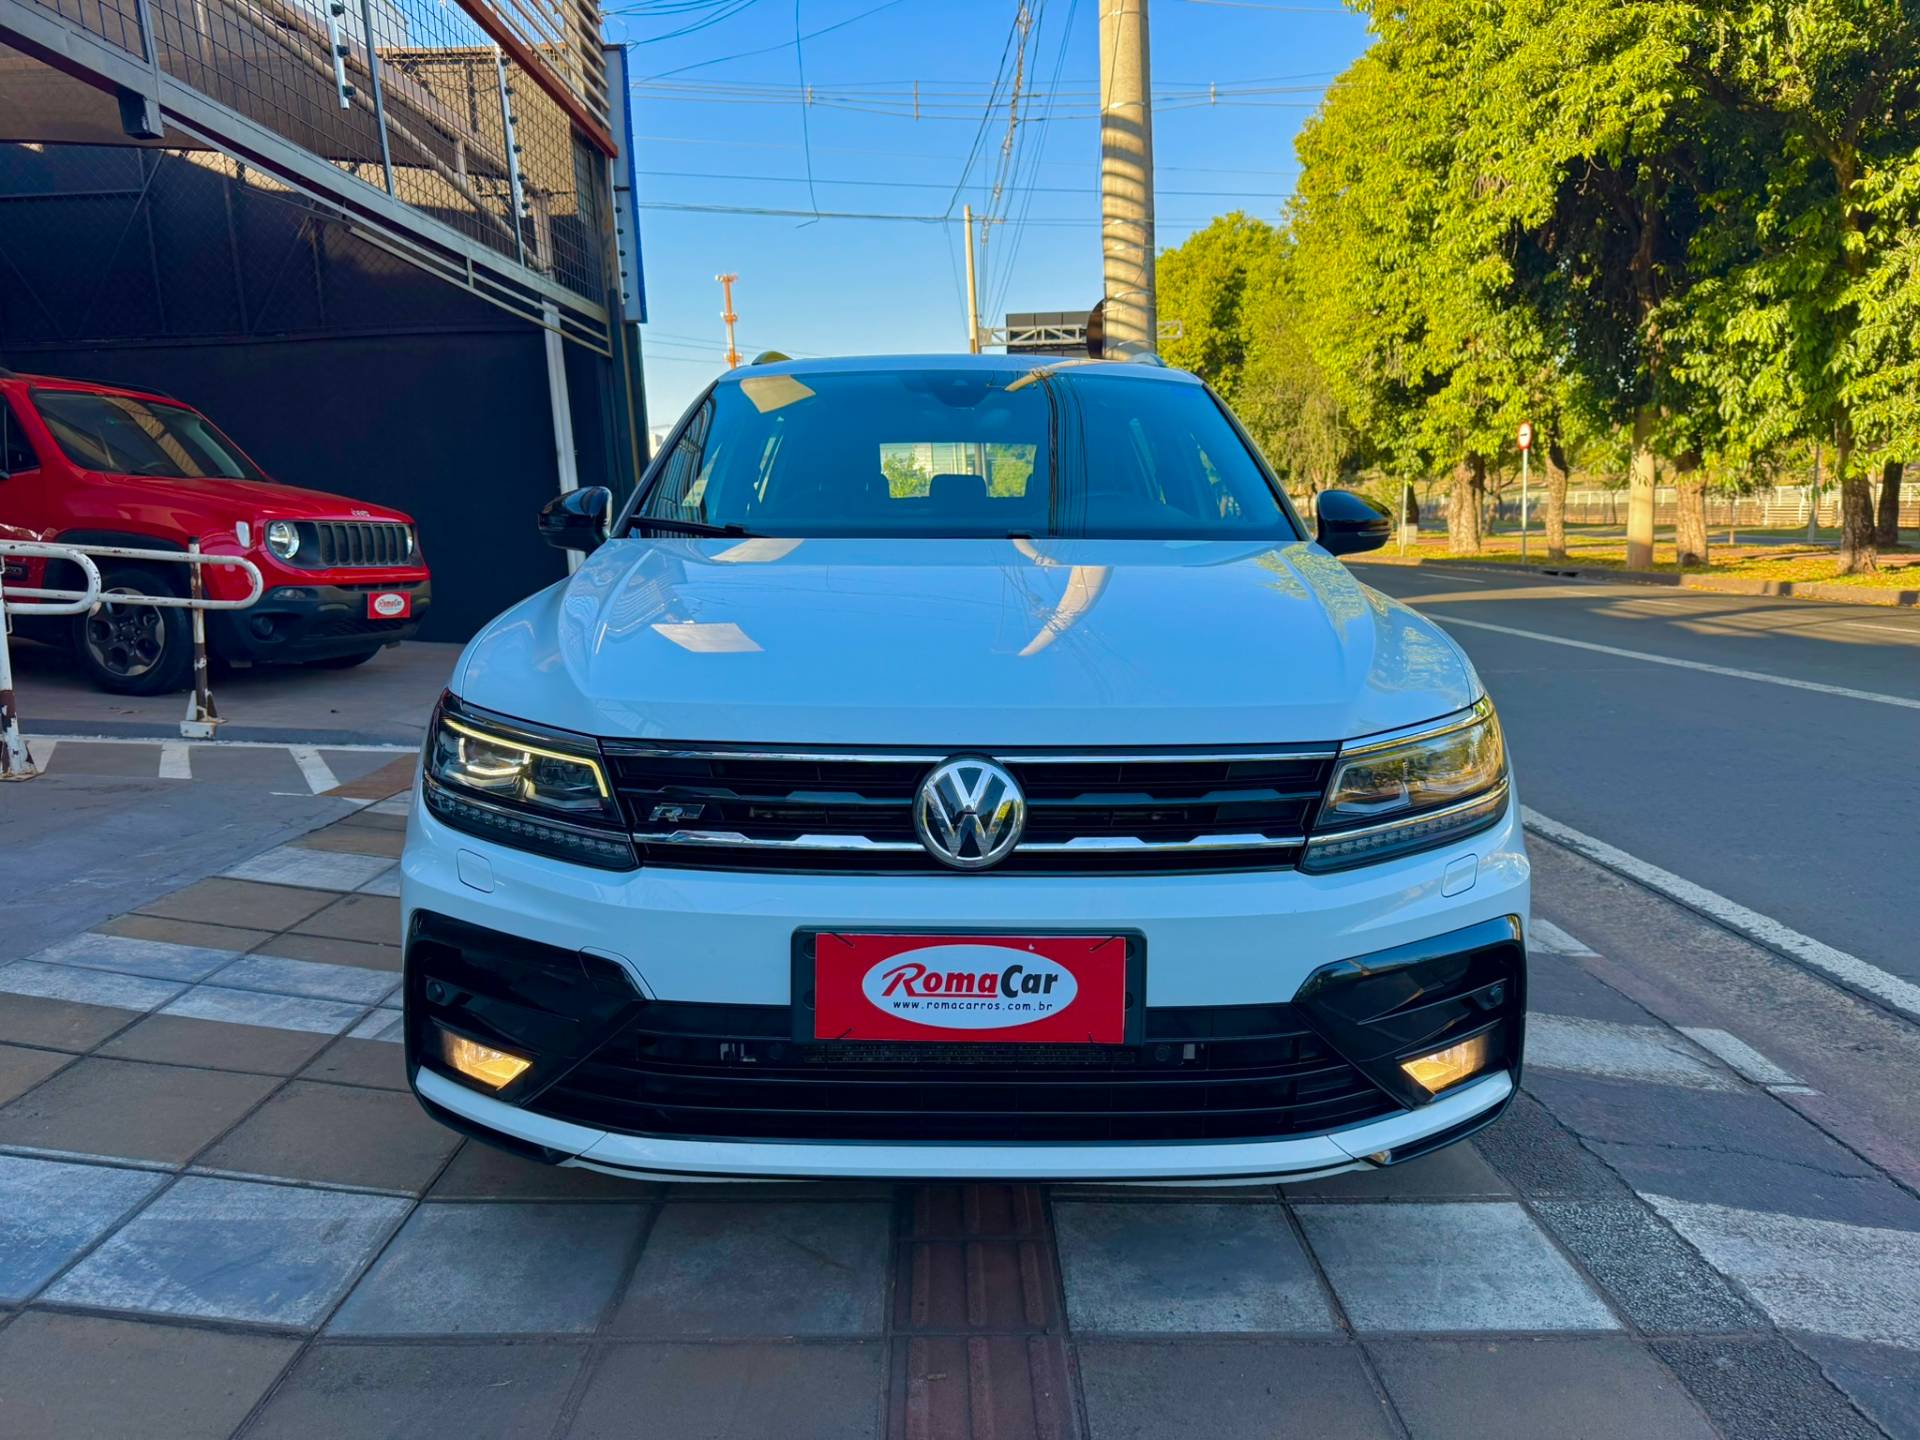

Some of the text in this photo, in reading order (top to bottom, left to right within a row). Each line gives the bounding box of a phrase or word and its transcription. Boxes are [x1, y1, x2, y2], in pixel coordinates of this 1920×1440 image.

[922, 760, 1022, 866] VW
[882, 963, 1058, 998] RomaCar
[893, 1001, 1053, 1011] www.romacarros.com.br
